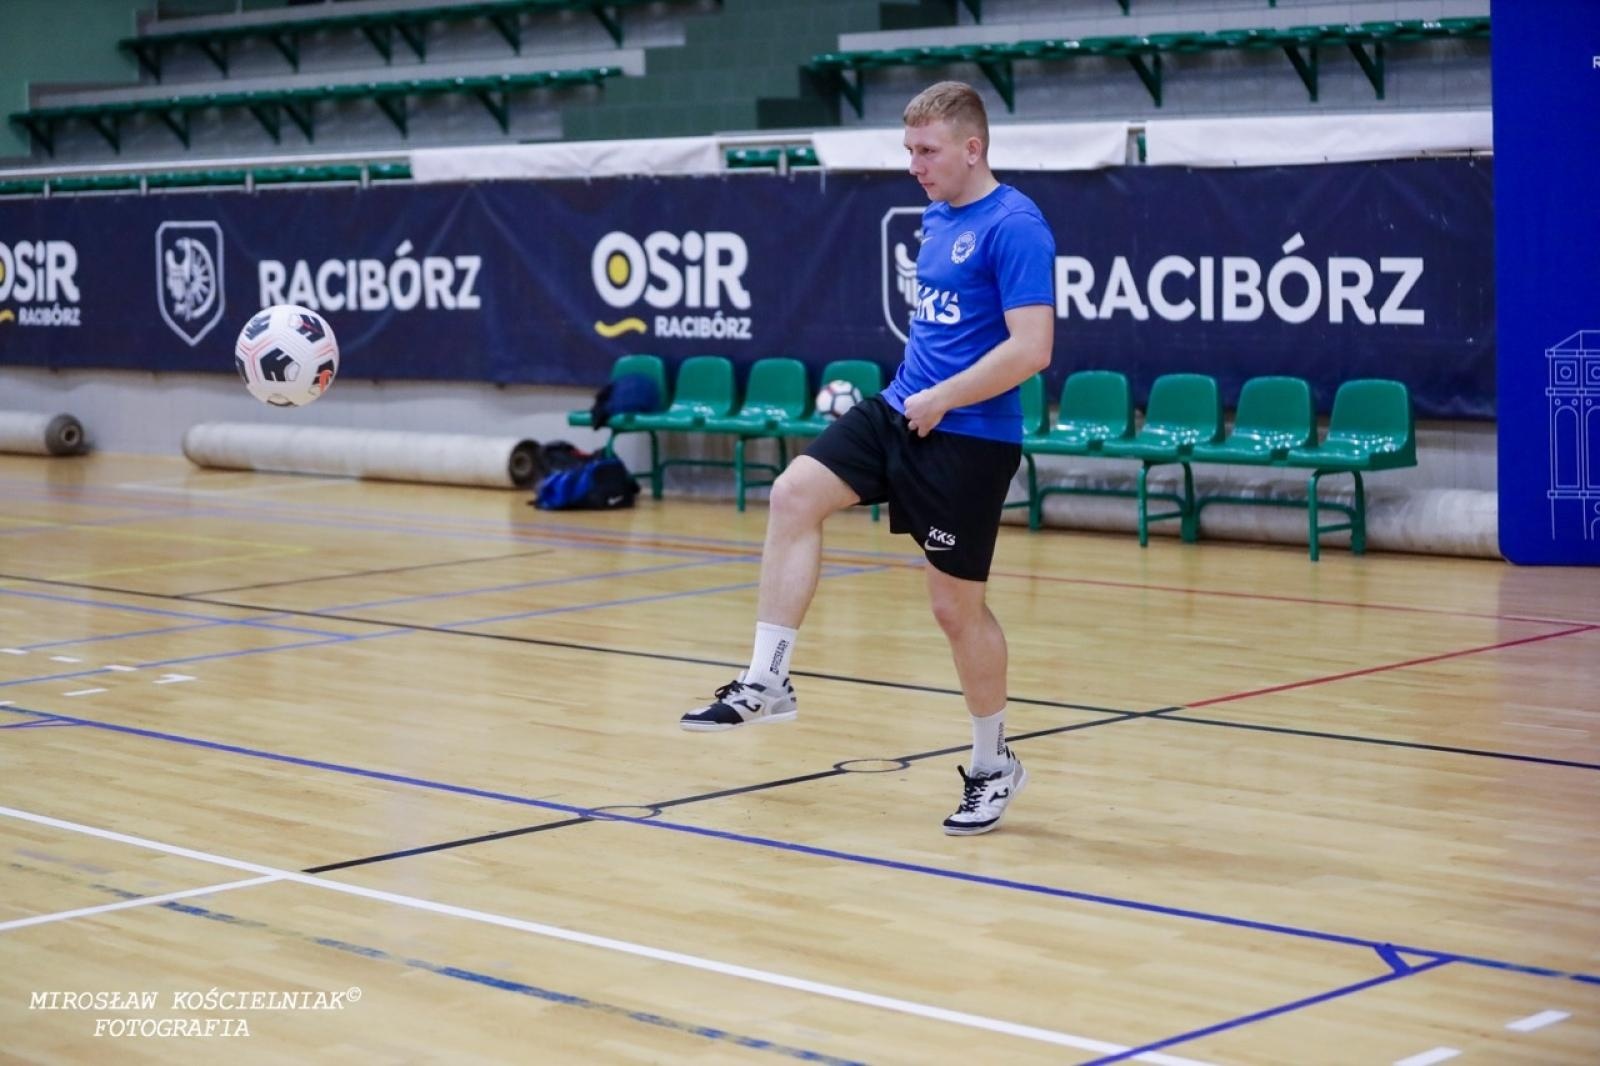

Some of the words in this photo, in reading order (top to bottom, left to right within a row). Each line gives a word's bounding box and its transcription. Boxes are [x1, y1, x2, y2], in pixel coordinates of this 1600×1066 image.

[259, 239, 482, 312] RACIBÓRZ
[1055, 232, 1424, 325] RACIBÓRZ
[18, 302, 82, 327] RACIBÓRZ
[654, 311, 752, 340] RACIBÓRZ
[928, 525, 956, 546] KKS
